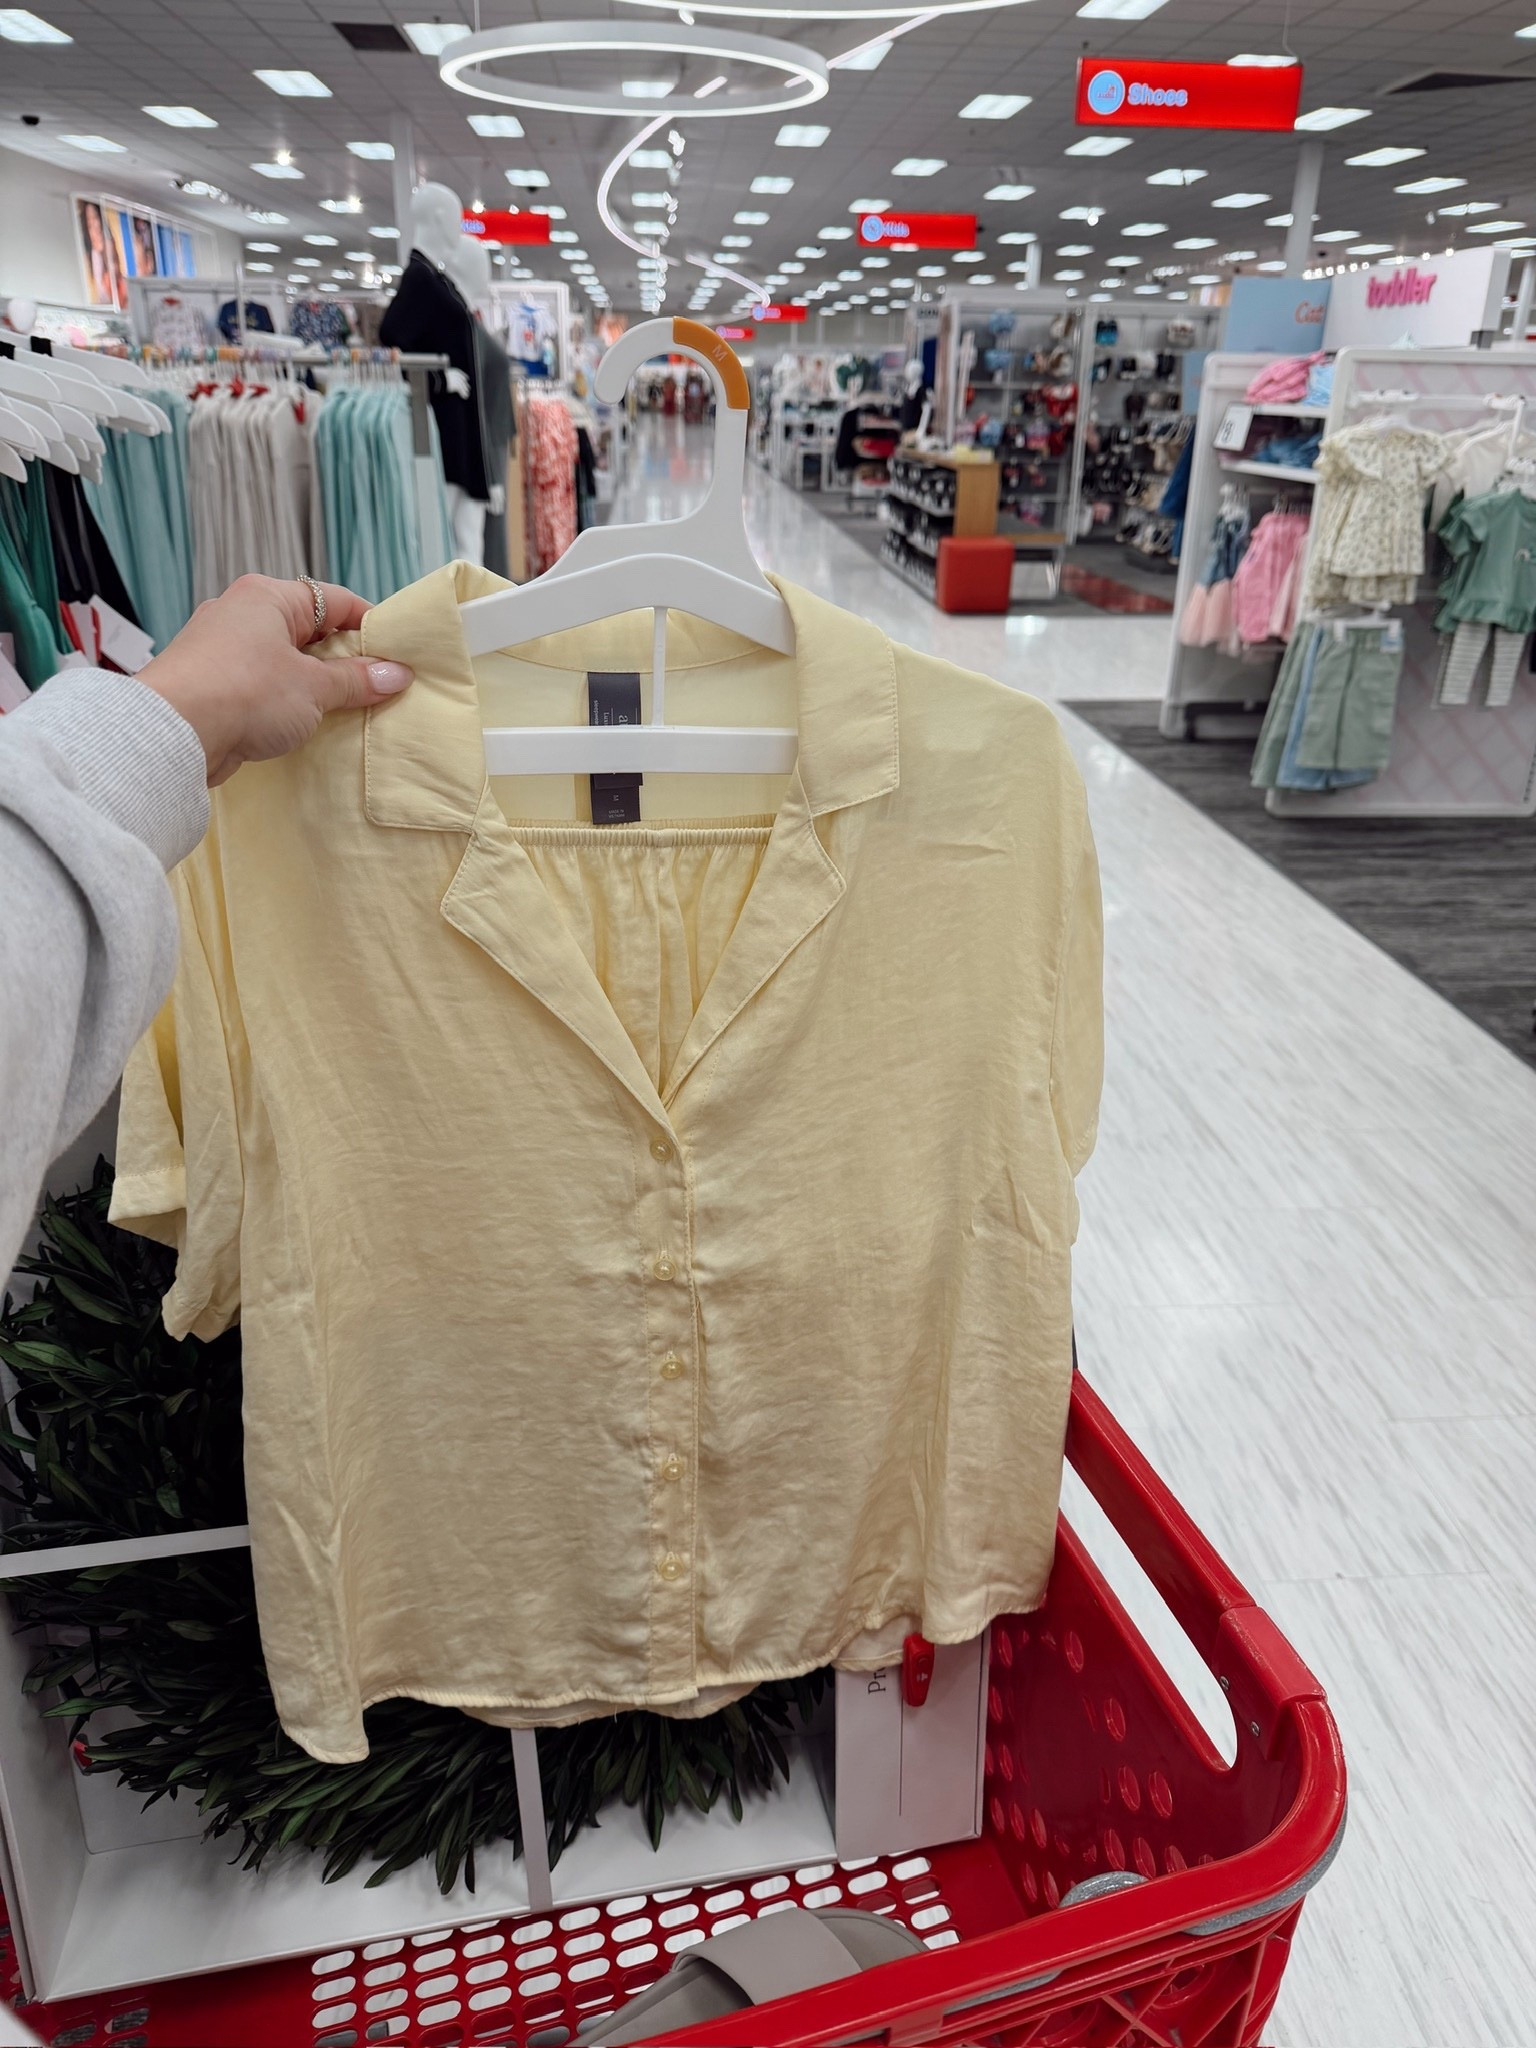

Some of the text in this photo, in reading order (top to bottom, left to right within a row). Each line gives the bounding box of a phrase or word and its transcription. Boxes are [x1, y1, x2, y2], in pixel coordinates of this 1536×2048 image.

[1128, 82, 1188, 107] Shoes
[1366, 267, 1438, 309] toddler
[711, 344, 729, 362] M
[867, 1667, 886, 1695] Pr
